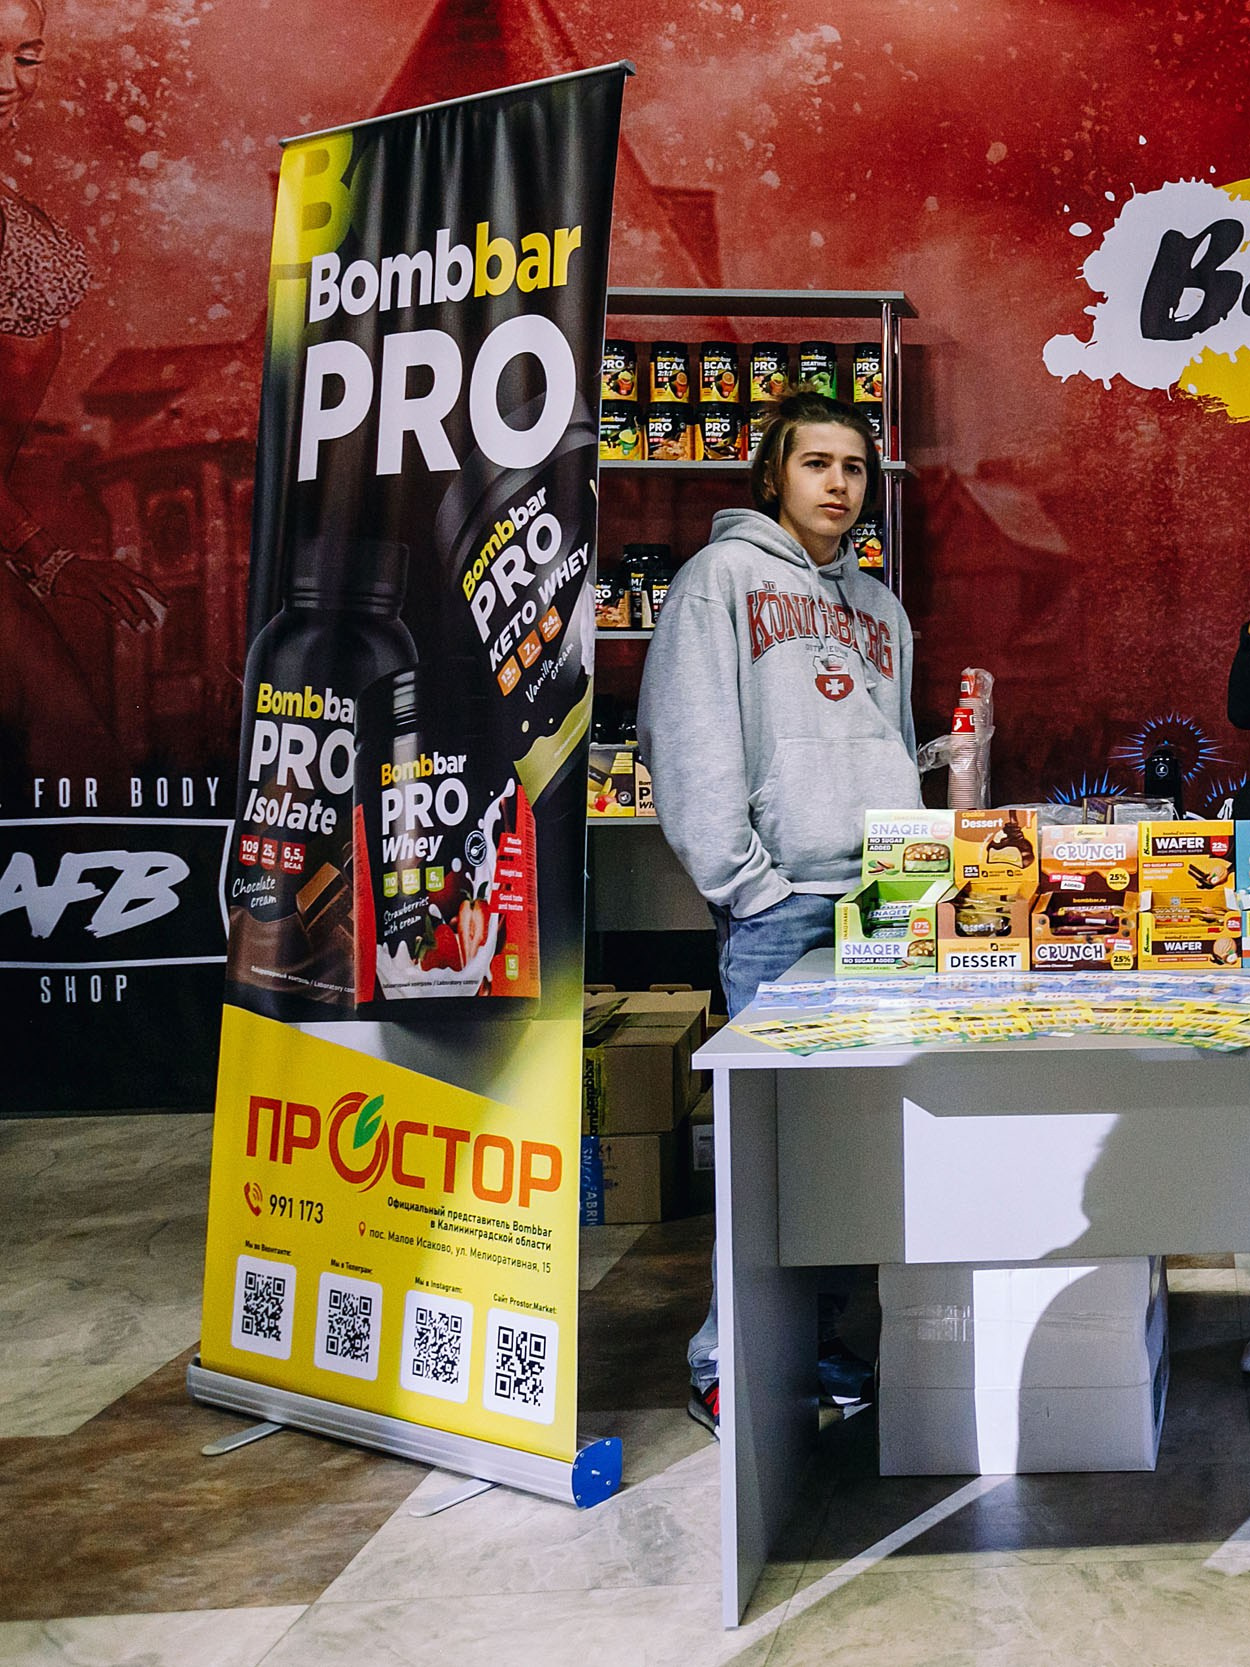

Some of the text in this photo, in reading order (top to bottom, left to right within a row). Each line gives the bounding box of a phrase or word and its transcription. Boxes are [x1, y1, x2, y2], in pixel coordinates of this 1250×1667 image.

[308, 221, 582, 323] Bombbar
[656, 361, 686, 371] BCAA
[703, 361, 732, 370] BCAA
[754, 361, 778, 371] PRO
[856, 362, 880, 372] PRO
[297, 314, 577, 482] PRO
[648, 422, 673, 432] PRO
[705, 422, 731, 432] PRO
[462, 486, 547, 601] Bombbar
[470, 512, 562, 644] PRO
[489, 600, 537, 672] KETO
[538, 542, 590, 605] WHEY
[550, 642, 575, 680] cream
[525, 659, 554, 703] Vanilla
[256, 682, 355, 724] Bombba
[248, 719, 356, 795] PRO
[380, 751, 467, 787] Bombbar
[34, 776, 220, 808] FOR BODY
[243, 788, 337, 836] Isolate
[381, 778, 469, 836] PRO
[870, 823, 929, 836] SNAQER
[961, 818, 1004, 829] Dessert
[242, 840, 259, 854] 109
[382, 833, 444, 864] Whey
[1055, 844, 1125, 859] CRUNCH
[1155, 837, 1205, 849] WAFER
[232, 875, 276, 898] Chocolate
[1109, 873, 1127, 881] 25%
[250, 895, 277, 908] cream
[384, 896, 430, 925] Strawberries
[843, 943, 901, 955] SNAQER
[1037, 945, 1103, 960] CRUNCH
[1113, 955, 1131, 963] 25%
[1164, 941, 1202, 951] WAFER
[950, 955, 1017, 968] DESSERT
[40, 974, 128, 1003] SHOP
[245, 1091, 563, 1208] ПРОСТОР
[269, 1195, 324, 1224] 991 173
[387, 1196, 553, 1238] Официальный представитель Bombbar
[430, 1220, 552, 1251] в Калининградской области
[369, 1229, 552, 1274] пос. Малое Исаково, ул. Мелиоративная, 15
[493, 1293, 508, 1303] Сайт
